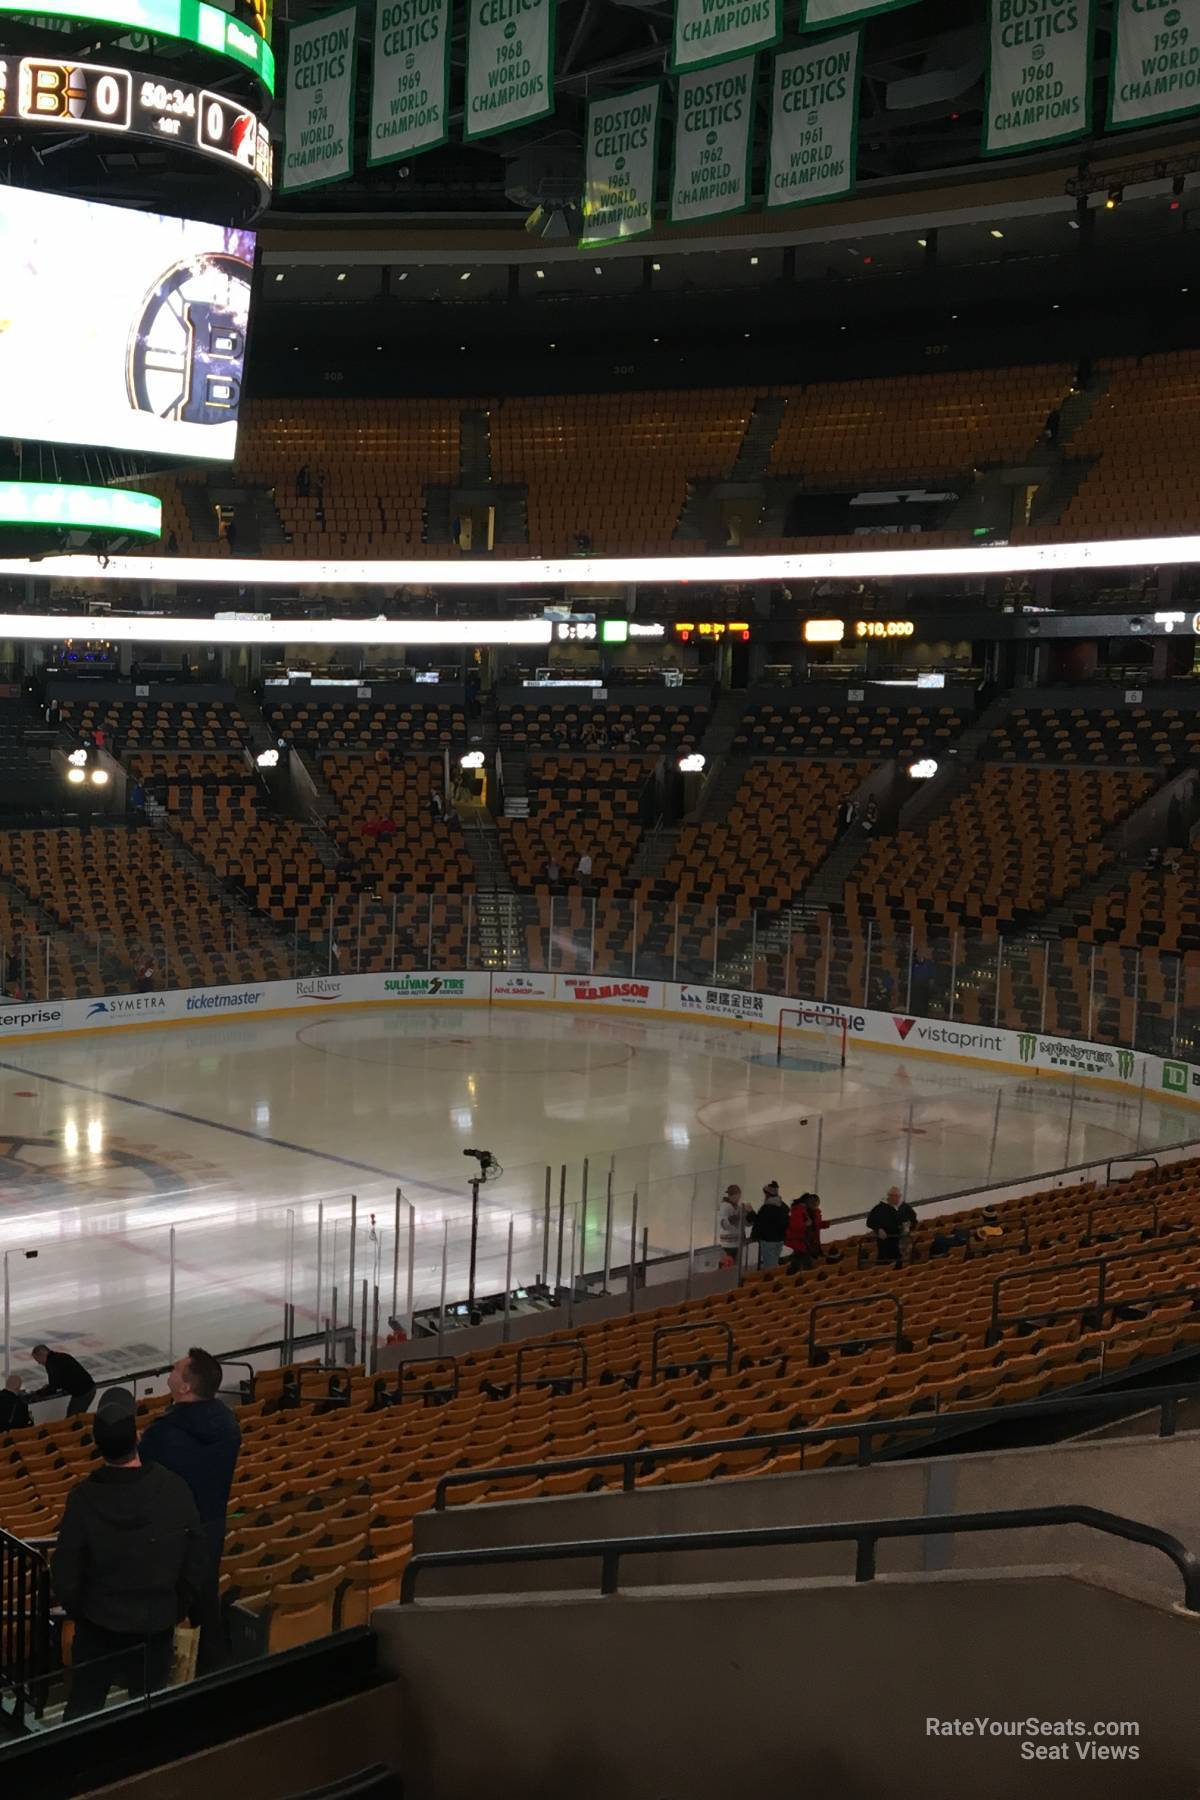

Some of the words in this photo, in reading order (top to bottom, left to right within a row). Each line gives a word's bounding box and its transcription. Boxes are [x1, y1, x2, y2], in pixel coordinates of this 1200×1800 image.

[684, 1, 769, 41] CHAMPIONS
[1002, 6, 1078, 47] CELTICS
[294, 28, 349, 65] BOSTON
[383, 15, 438, 56] CELTICS
[1154, 27, 1189, 52] 1959
[497, 40, 522, 64] 1968
[295, 55, 345, 90] CELTICS
[398, 71, 421, 93] 1969
[488, 60, 530, 88] WORLD
[781, 51, 850, 89] BOSTON
[1022, 62, 1054, 84] 1960
[96, 75, 120, 115] 0
[390, 90, 427, 116] WORLD
[472, 75, 543, 112] CHAMPIONS
[684, 74, 746, 109] BOSTON
[783, 77, 845, 113] CELTICS
[1011, 81, 1063, 107] WORLD
[207, 102, 224, 140] 0
[308, 106, 328, 125] 1974
[376, 105, 439, 139] CHAMPIONS
[594, 104, 651, 136] BOSTON
[685, 99, 742, 132] CELTICS
[994, 96, 1079, 130] CHAMPIONS
[300, 124, 334, 147] WORLD
[595, 127, 647, 157] CELTICS
[800, 127, 822, 146] 1961
[287, 139, 343, 168] CHAMPIONS
[700, 147, 723, 165] 1962
[790, 145, 832, 167] WORLD
[608, 172, 630, 187] 1963
[691, 163, 731, 185] WORLD
[774, 160, 845, 188] CHAMPIONS
[600, 188, 636, 207] WORLD
[857, 621, 913, 638] $10,000
[296, 981, 315, 995] Red
[316, 980, 341, 993] River
[443, 979, 464, 989] TIRE
[110, 997, 166, 1012] SYMETRA
[186, 992, 261, 1010] ticketmaster
[918, 1025, 1003, 1051] vistaprint
